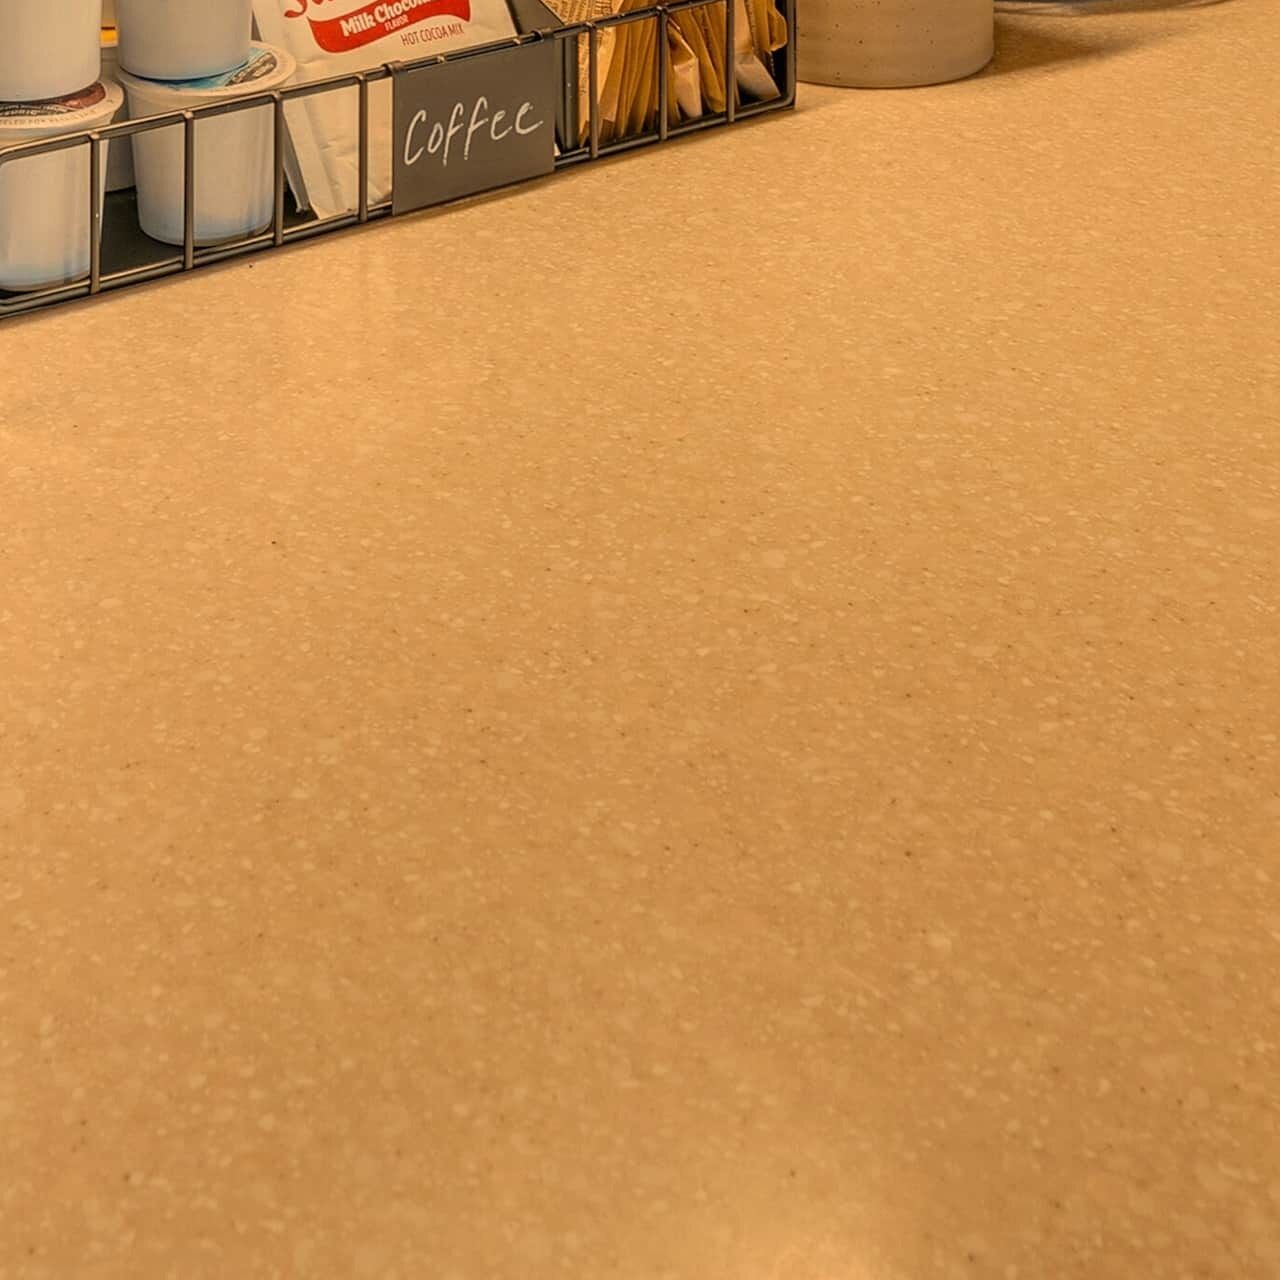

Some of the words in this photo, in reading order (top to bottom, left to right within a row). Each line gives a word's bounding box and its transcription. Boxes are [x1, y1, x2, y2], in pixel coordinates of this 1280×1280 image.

[340, 11, 376, 37] Milk
[384, 14, 409, 32] FLAVOR
[400, 31, 419, 47] HOT
[419, 24, 450, 42] COCOA
[448, 22, 465, 36] MIX
[404, 95, 545, 167] Coffee
